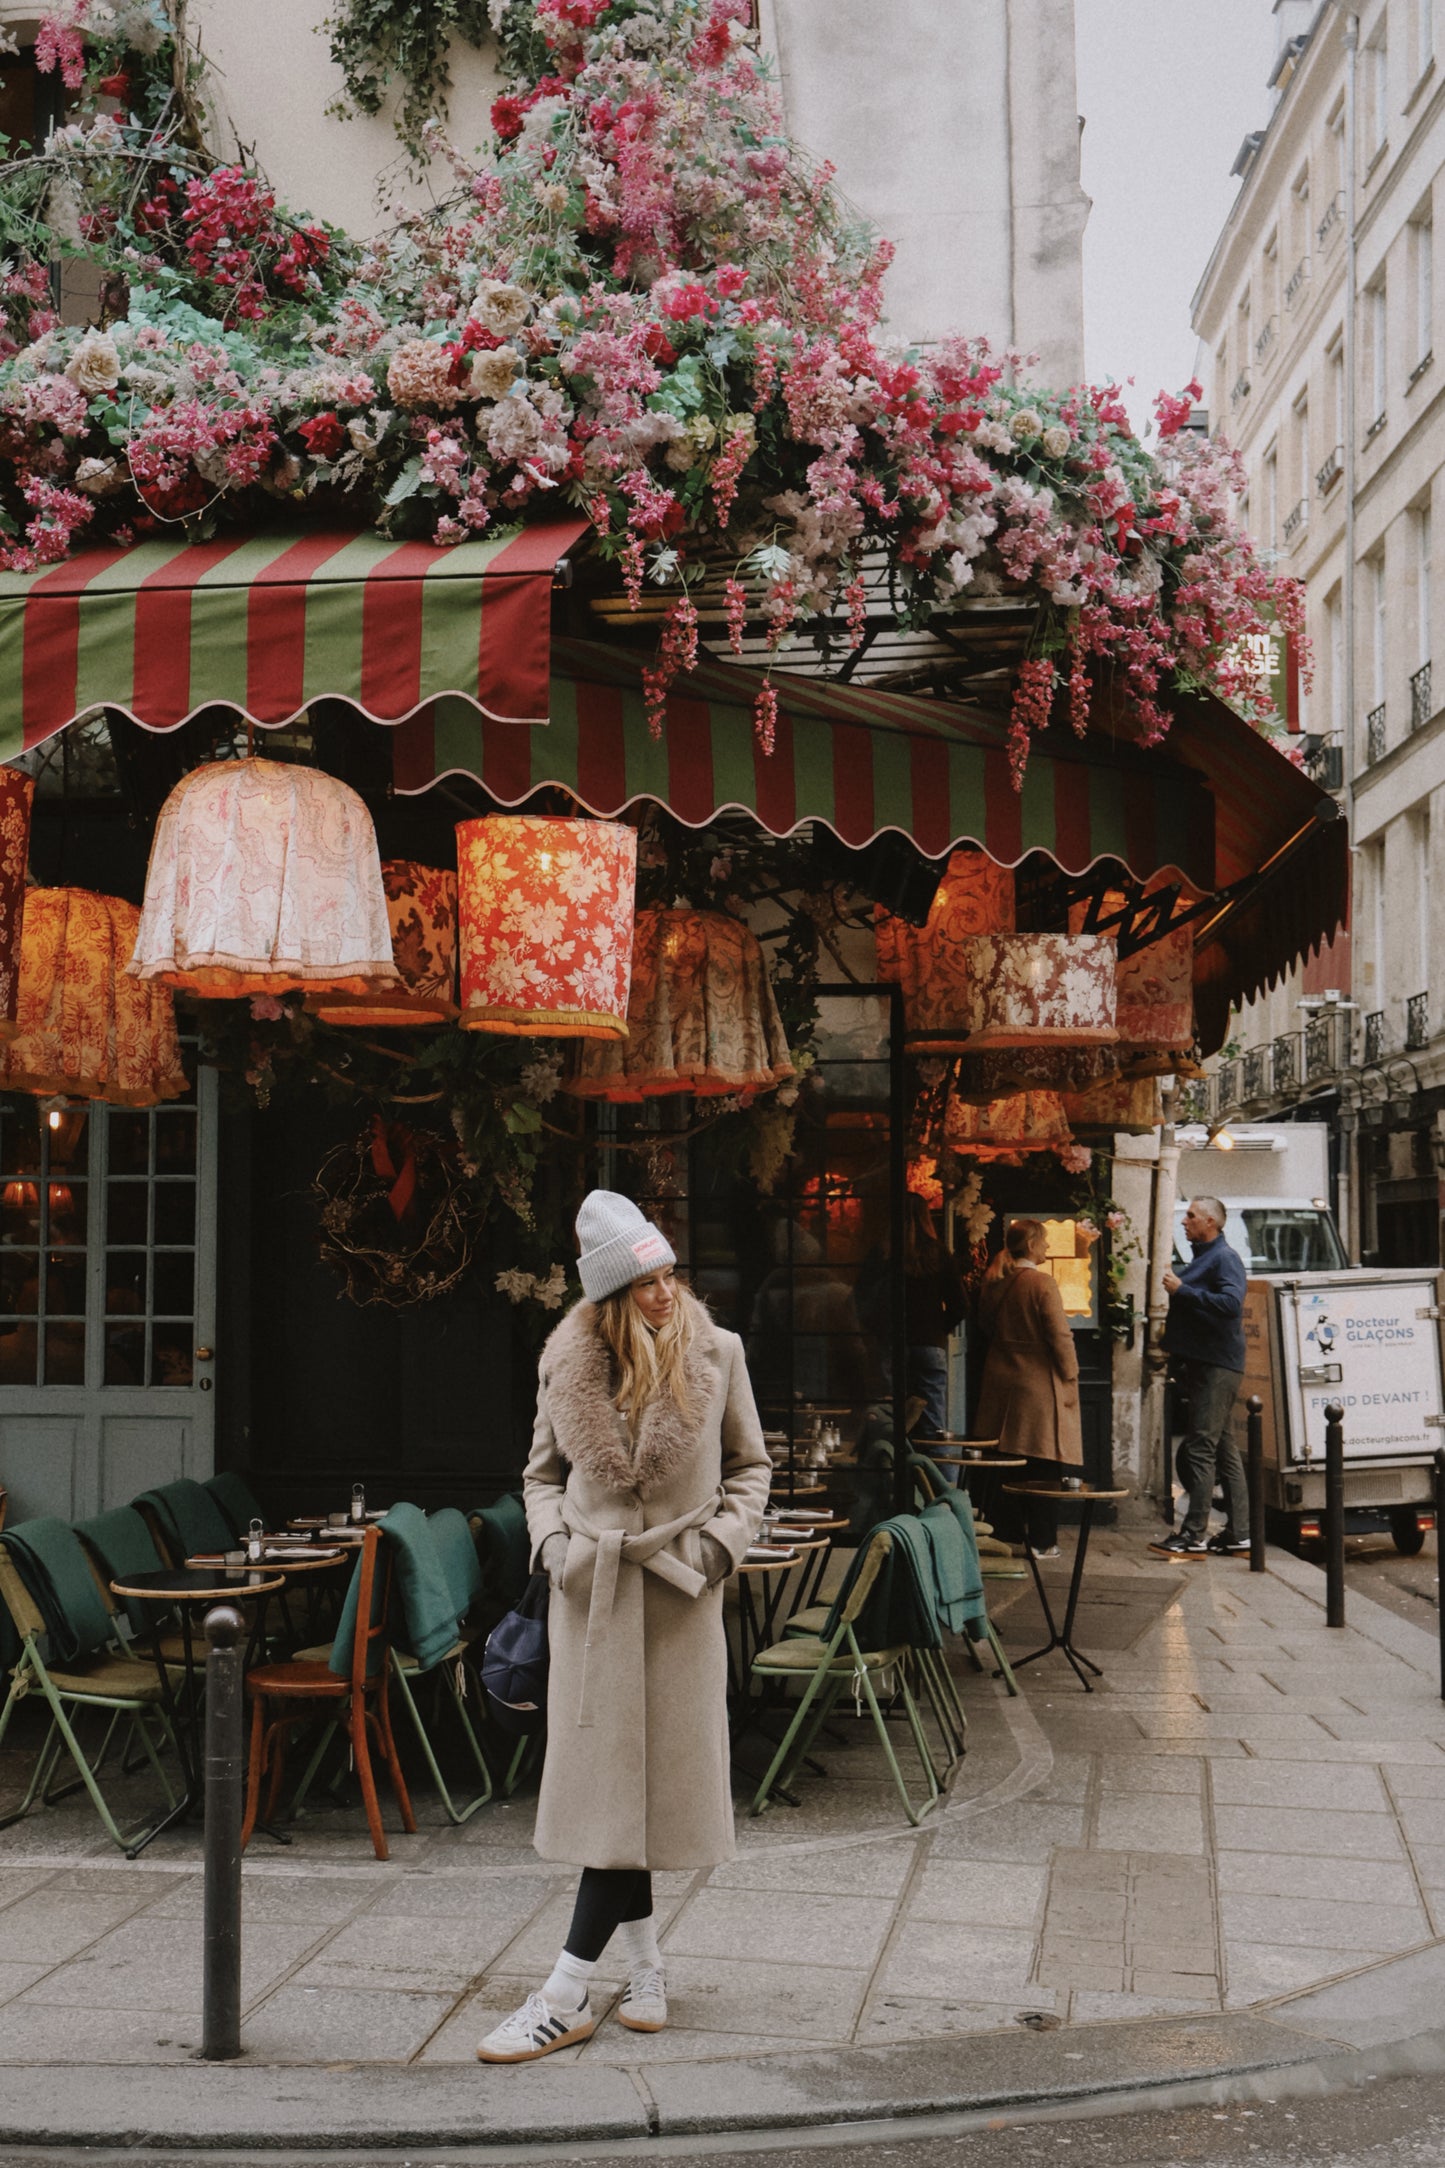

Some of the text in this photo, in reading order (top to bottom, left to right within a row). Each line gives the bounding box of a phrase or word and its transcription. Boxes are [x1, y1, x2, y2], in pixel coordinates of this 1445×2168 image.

[1346, 1317, 1400, 1328] Docteur
[1346, 1328, 1415, 1343] GLAÇONS
[1362, 1391, 1420, 1406] DEVANT
